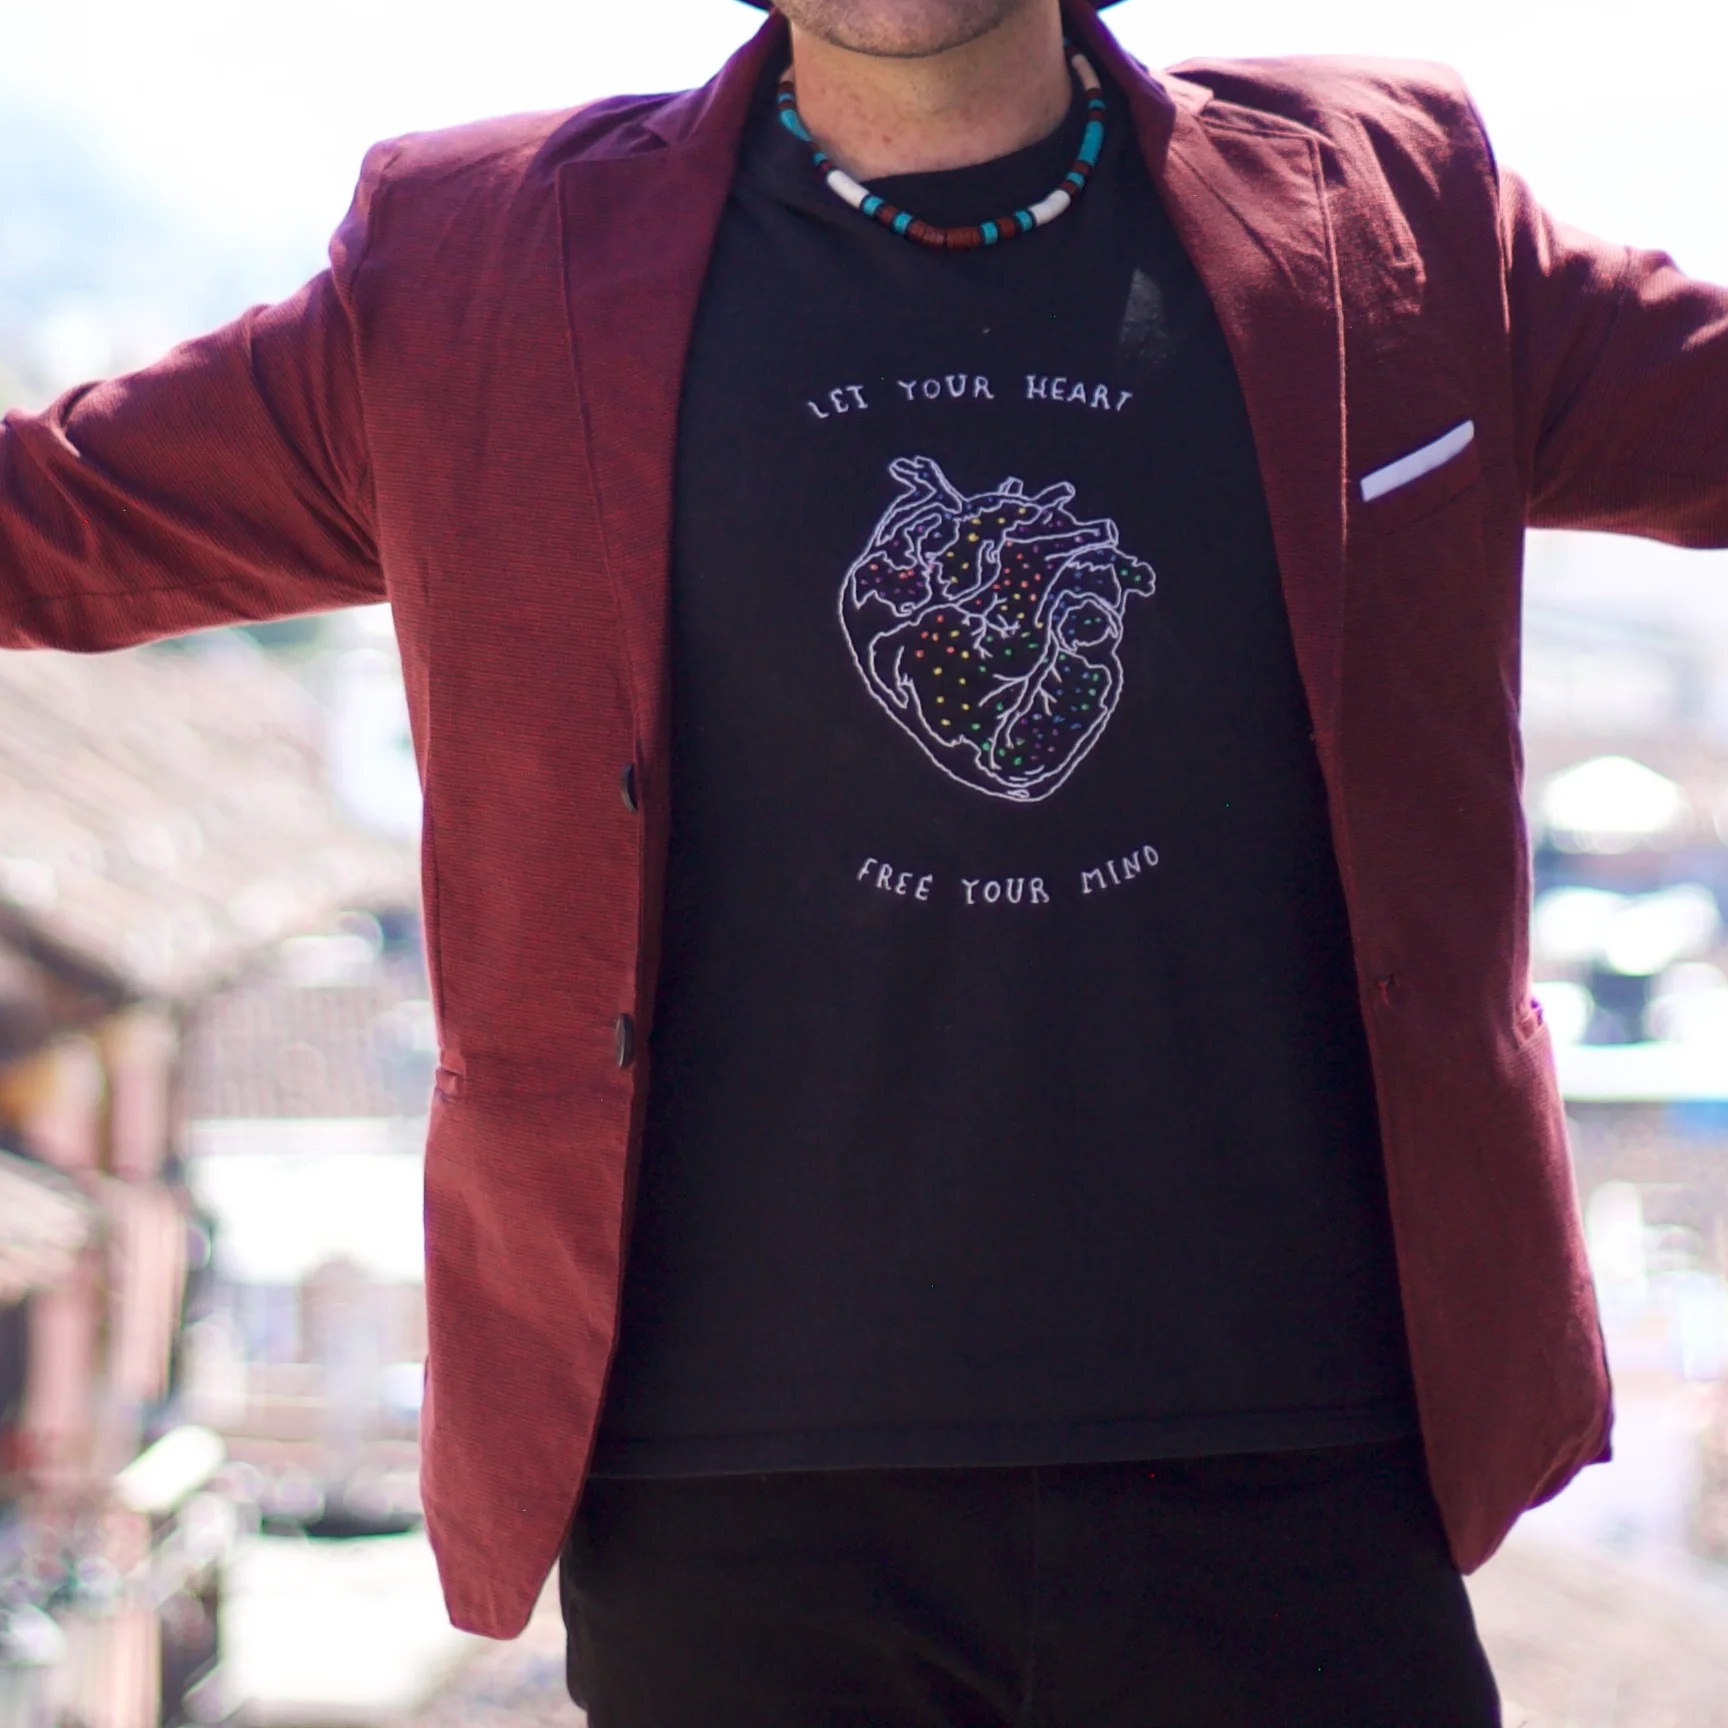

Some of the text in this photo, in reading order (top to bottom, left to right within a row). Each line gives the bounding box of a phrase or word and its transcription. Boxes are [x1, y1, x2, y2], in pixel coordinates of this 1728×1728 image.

[807, 373, 1133, 419] LET YOUR HEART
[856, 845, 1159, 905] FREE YOUR MIND
